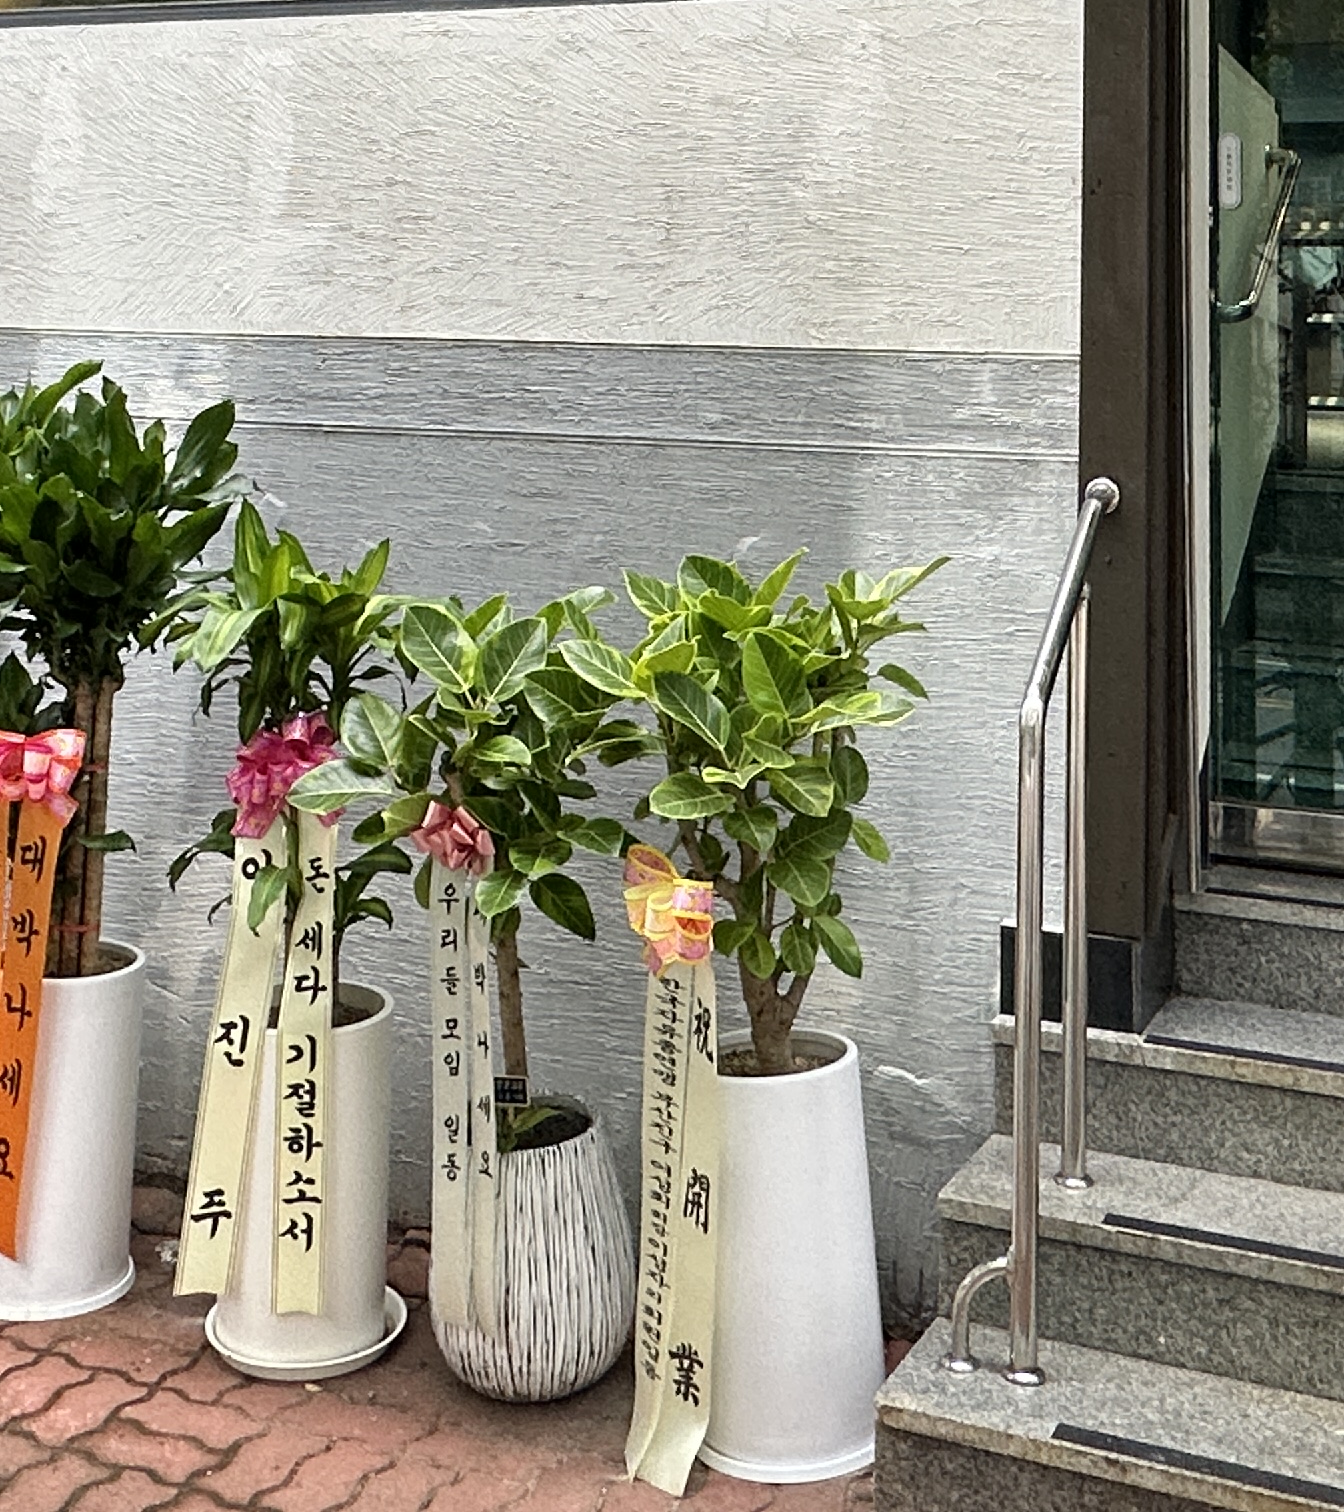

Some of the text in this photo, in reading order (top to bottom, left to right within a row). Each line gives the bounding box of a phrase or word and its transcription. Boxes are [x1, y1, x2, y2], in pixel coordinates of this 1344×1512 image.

[279, 857, 330, 1254] 돈 세다 기절하소서
